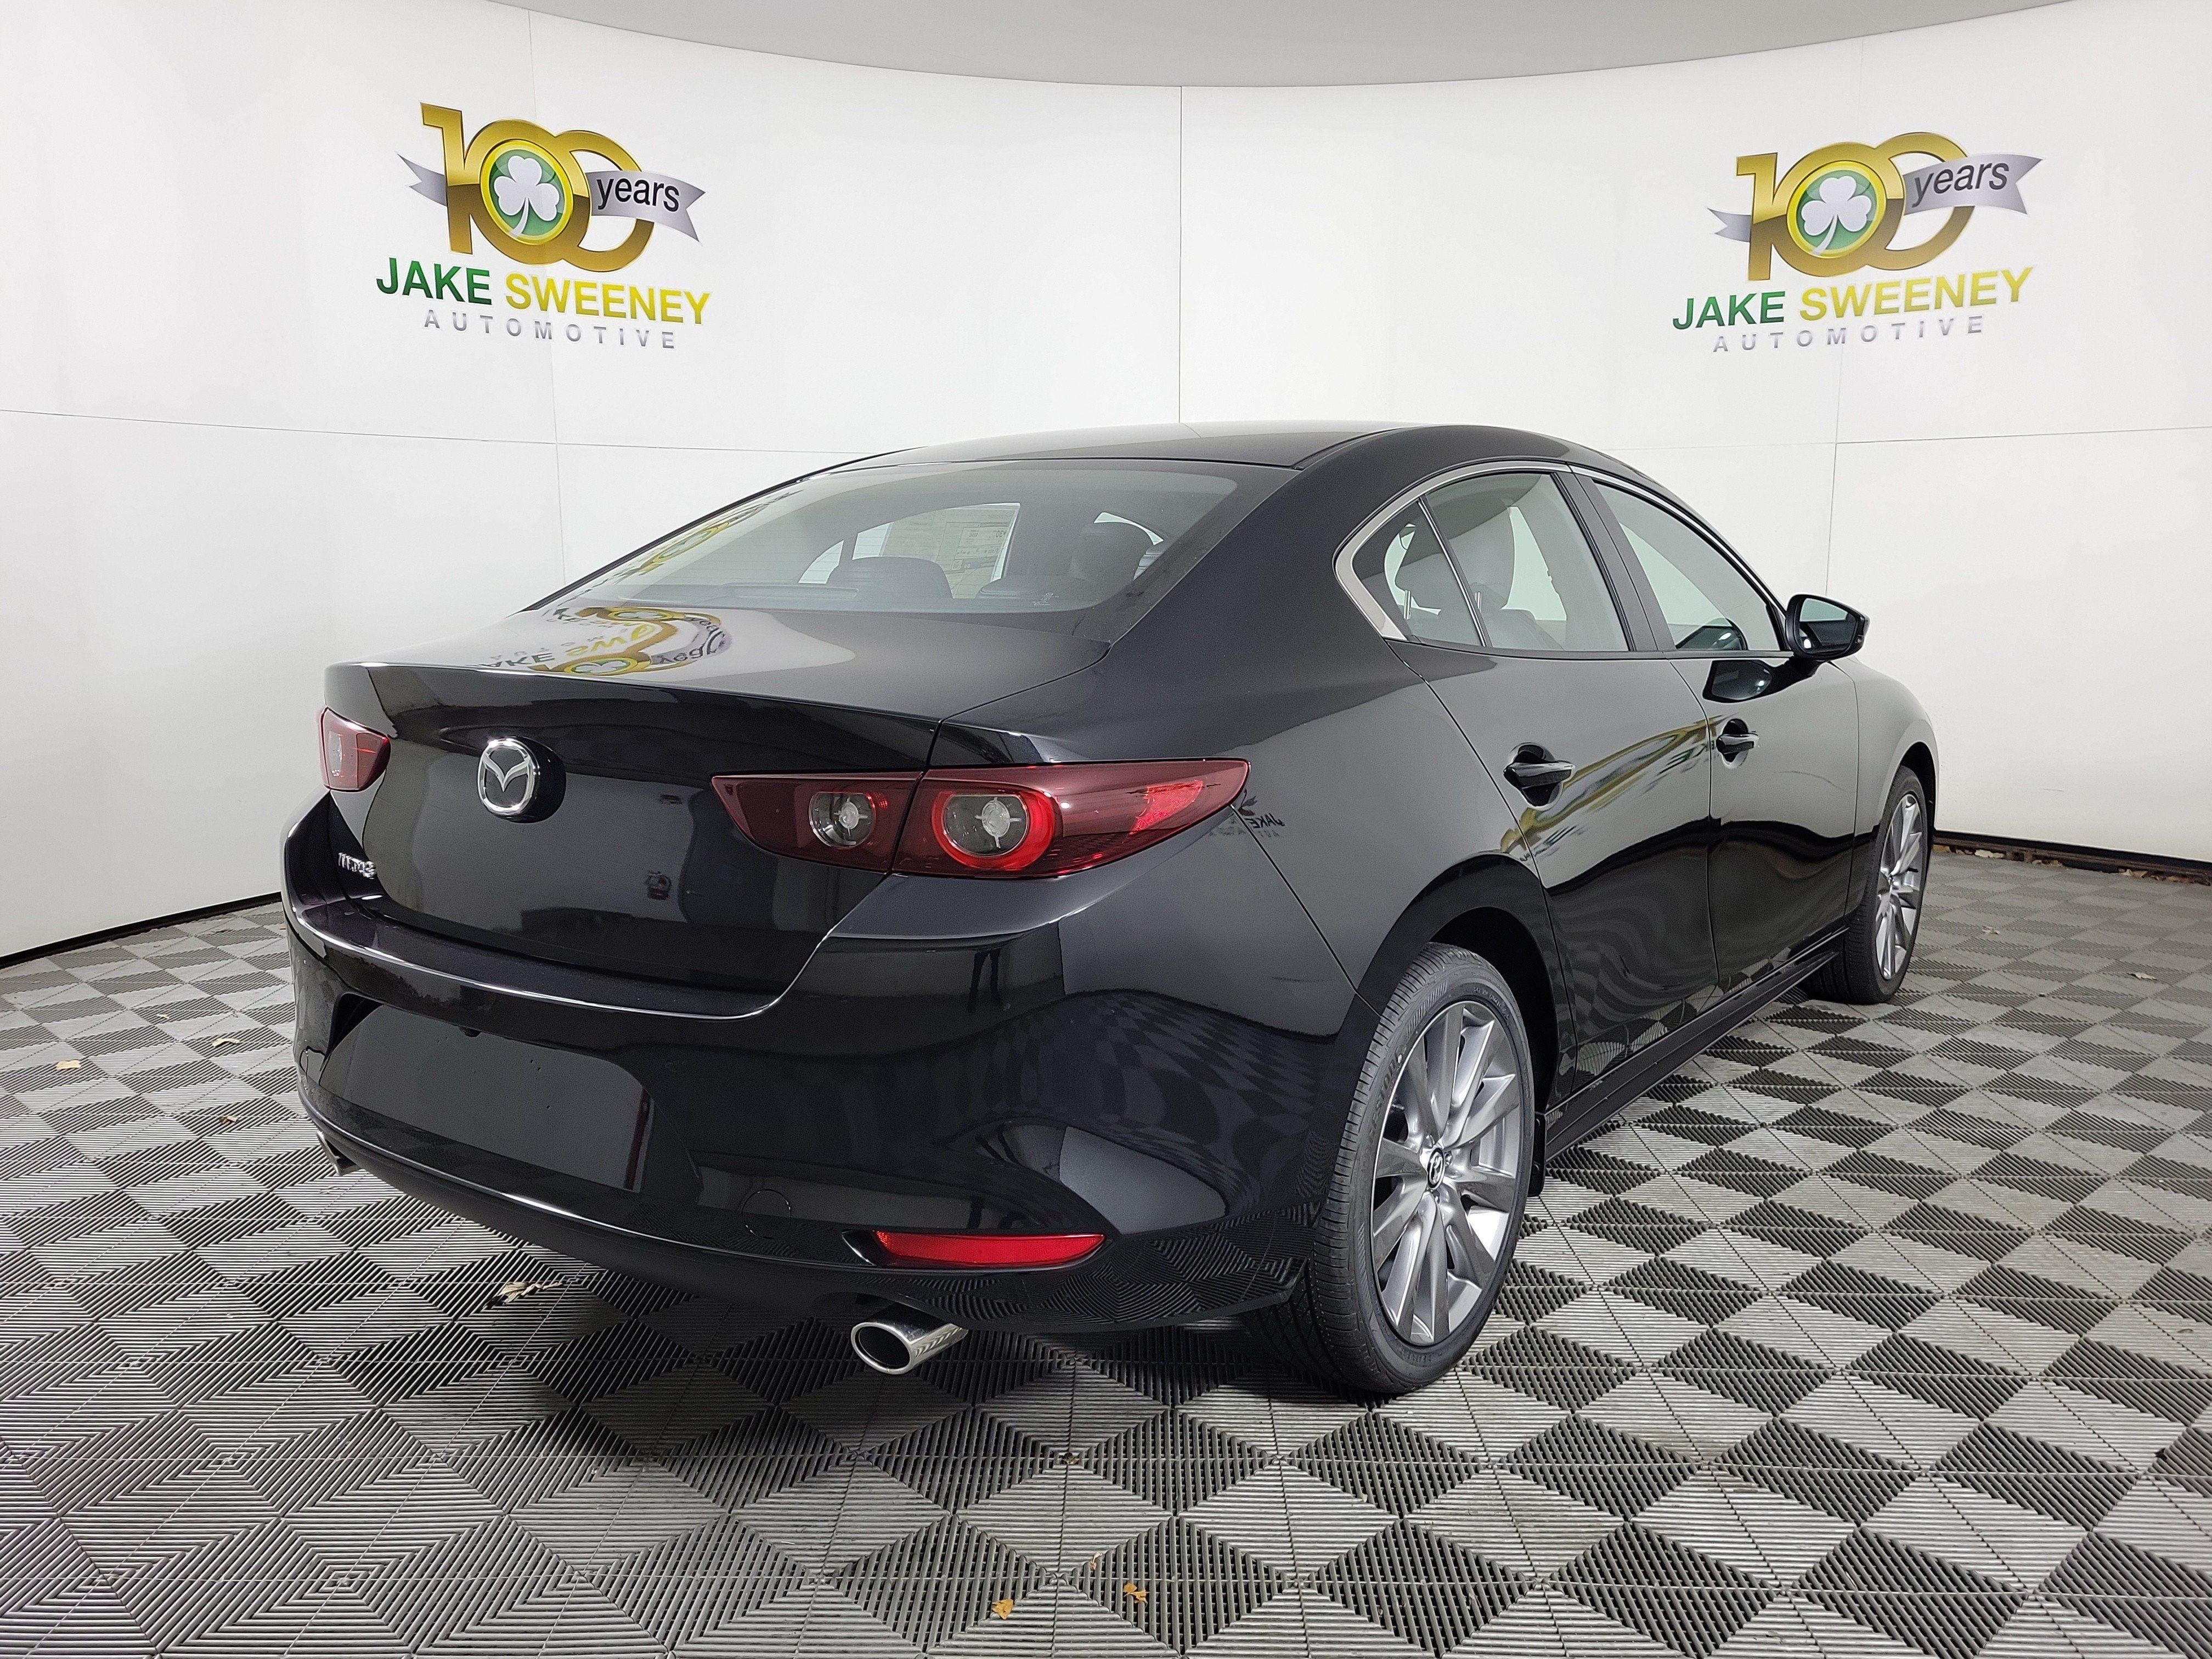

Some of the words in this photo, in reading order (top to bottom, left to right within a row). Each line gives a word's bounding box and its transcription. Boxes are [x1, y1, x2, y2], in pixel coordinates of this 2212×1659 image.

[420, 101, 654, 273] 100
[596, 176, 680, 212] years
[1736, 131, 1976, 281] 100
[1911, 161, 2009, 208] years
[376, 257, 492, 306] JAKE
[505, 273, 710, 325] SWEENEY
[1672, 290, 1786, 330] JAKE
[1799, 267, 2034, 322] SWEENEY
[424, 309, 675, 349] AUTOMOTIVE
[1713, 315, 1983, 353] AUTOMOTIVE
